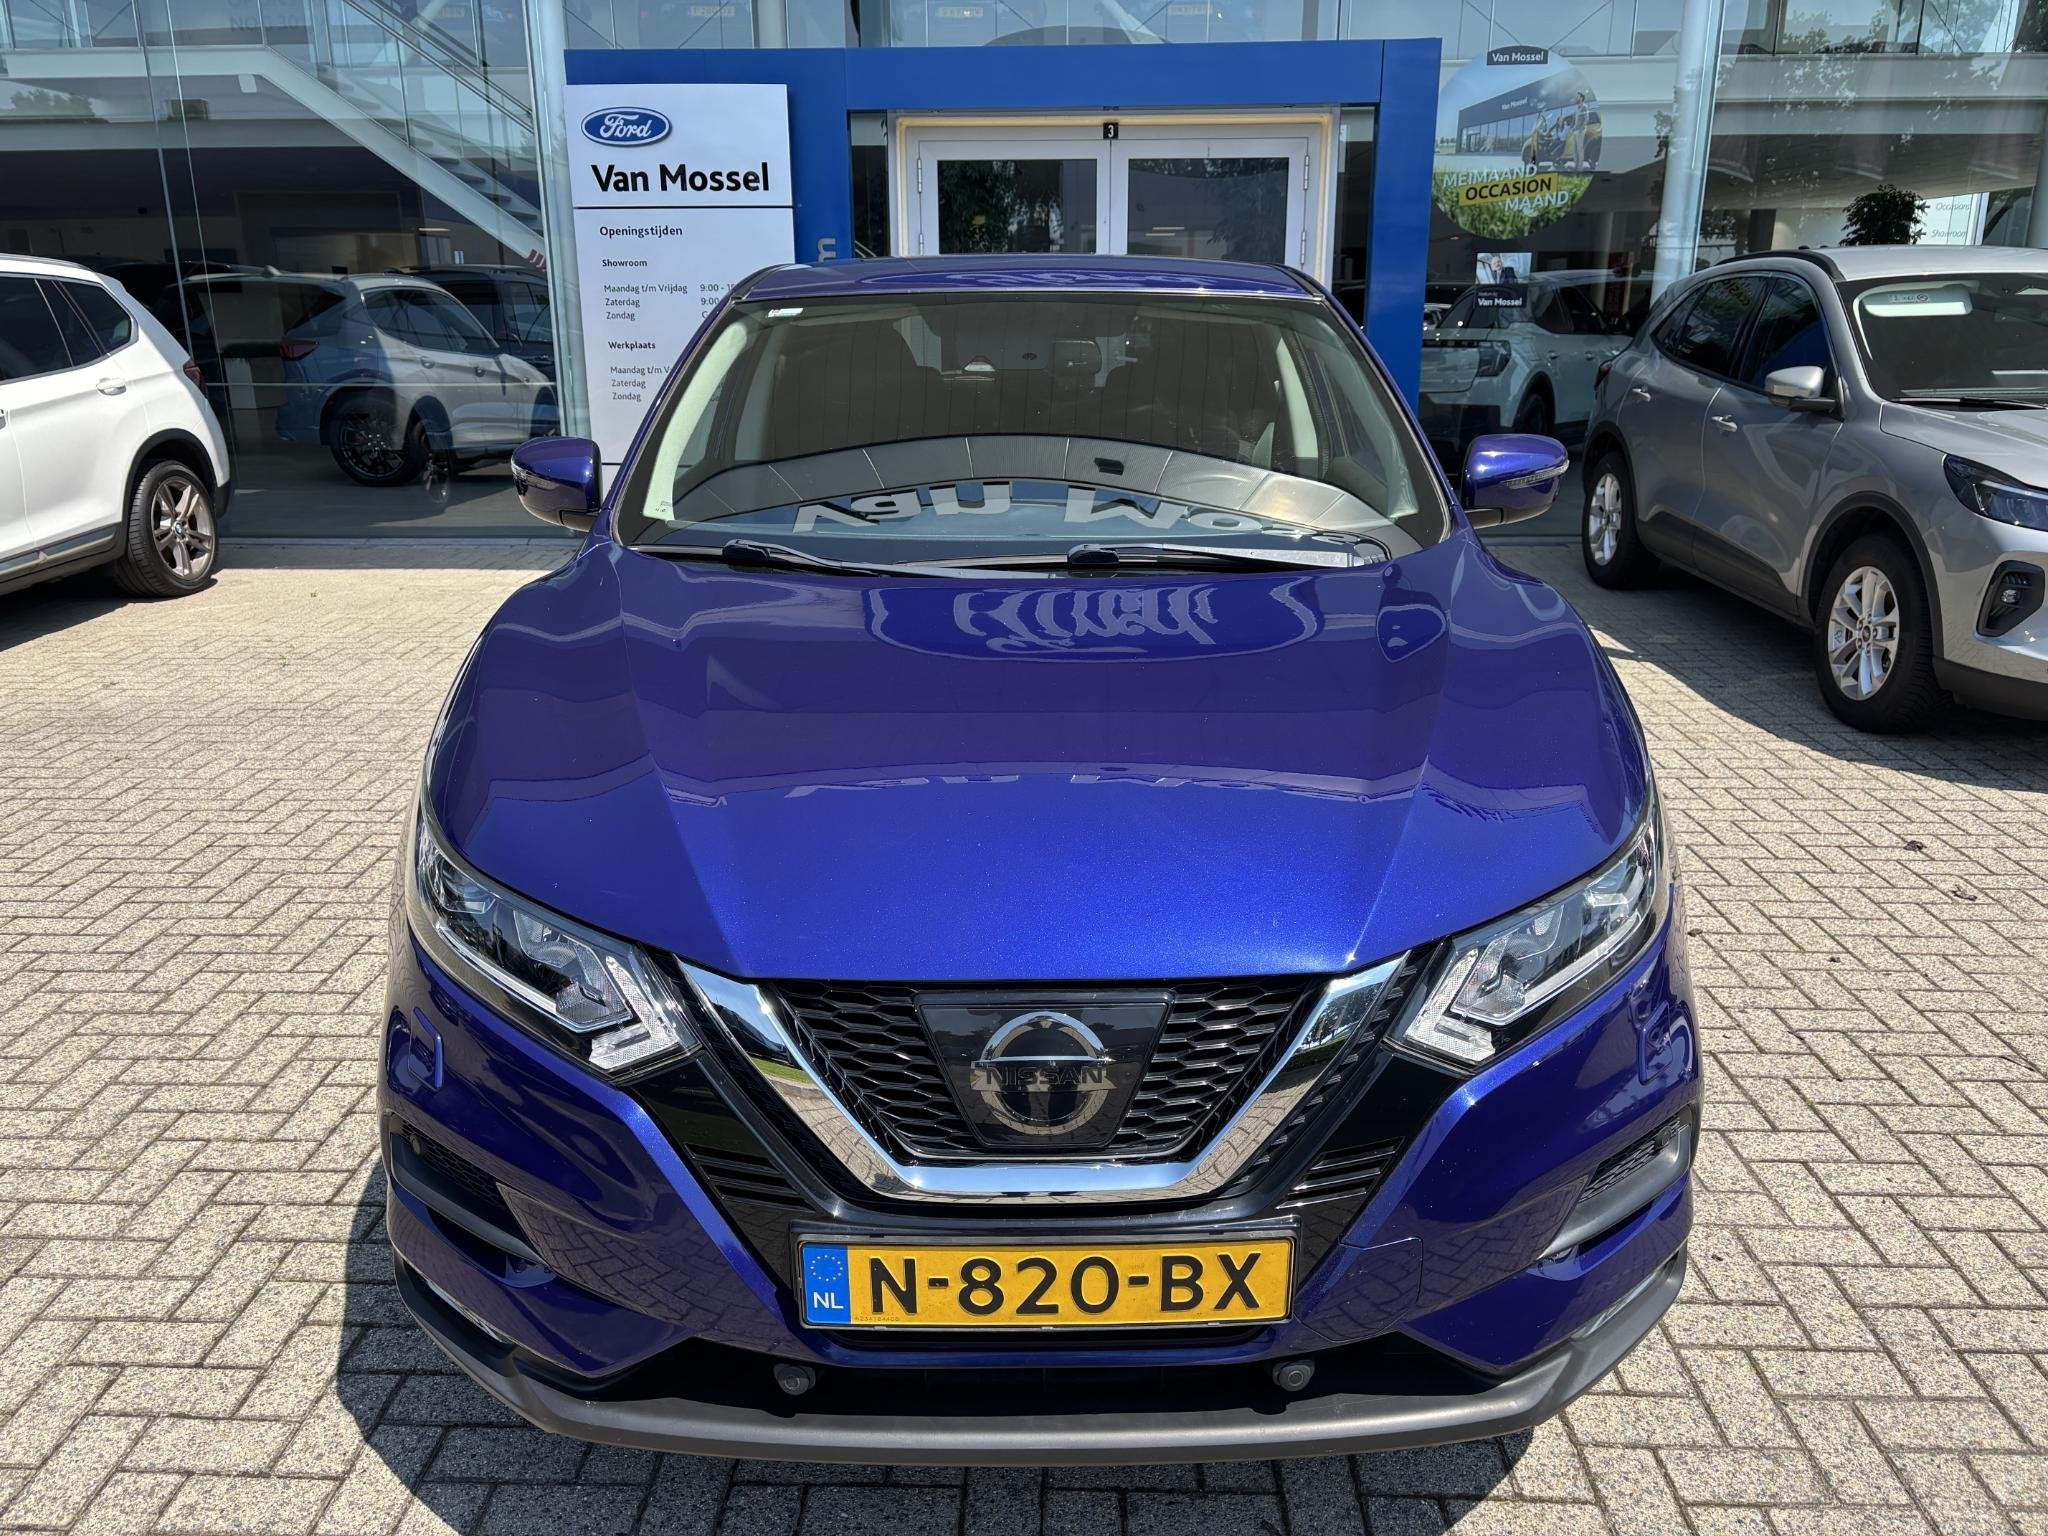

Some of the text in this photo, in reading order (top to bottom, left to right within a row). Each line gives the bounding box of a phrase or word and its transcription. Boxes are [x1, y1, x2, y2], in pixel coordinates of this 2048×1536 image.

[1492, 51, 1544, 63] Van Mossel
[600, 113, 653, 138] Ford
[1107, 124, 1114, 138] 3
[591, 162, 770, 192] Van Mossel
[1465, 177, 1552, 201] OCCASION
[1504, 190, 1569, 212] MAAND
[600, 225, 683, 239] Openingstijden
[602, 259, 648, 268] Showroom
[604, 284, 640, 295] Maandag
[641, 283, 657, 293] t/m
[658, 284, 688, 295] Vrijdag
[700, 283, 719, 292] 9:00
[605, 298, 640, 308] Zaterdag
[1478, 297, 1522, 306] Van Mossel
[606, 312, 636, 322] Zondag
[608, 341, 656, 351] Werkplaats
[610, 366, 645, 376] Maandag
[647, 366, 662, 374] t/m
[611, 379, 646, 390] Zaterdag
[612, 392, 641, 402] Zondag
[985, 1065, 1107, 1085] NISSAN
[869, 1252, 1262, 1315] N-820-BX
[813, 1291, 844, 1309] NL
